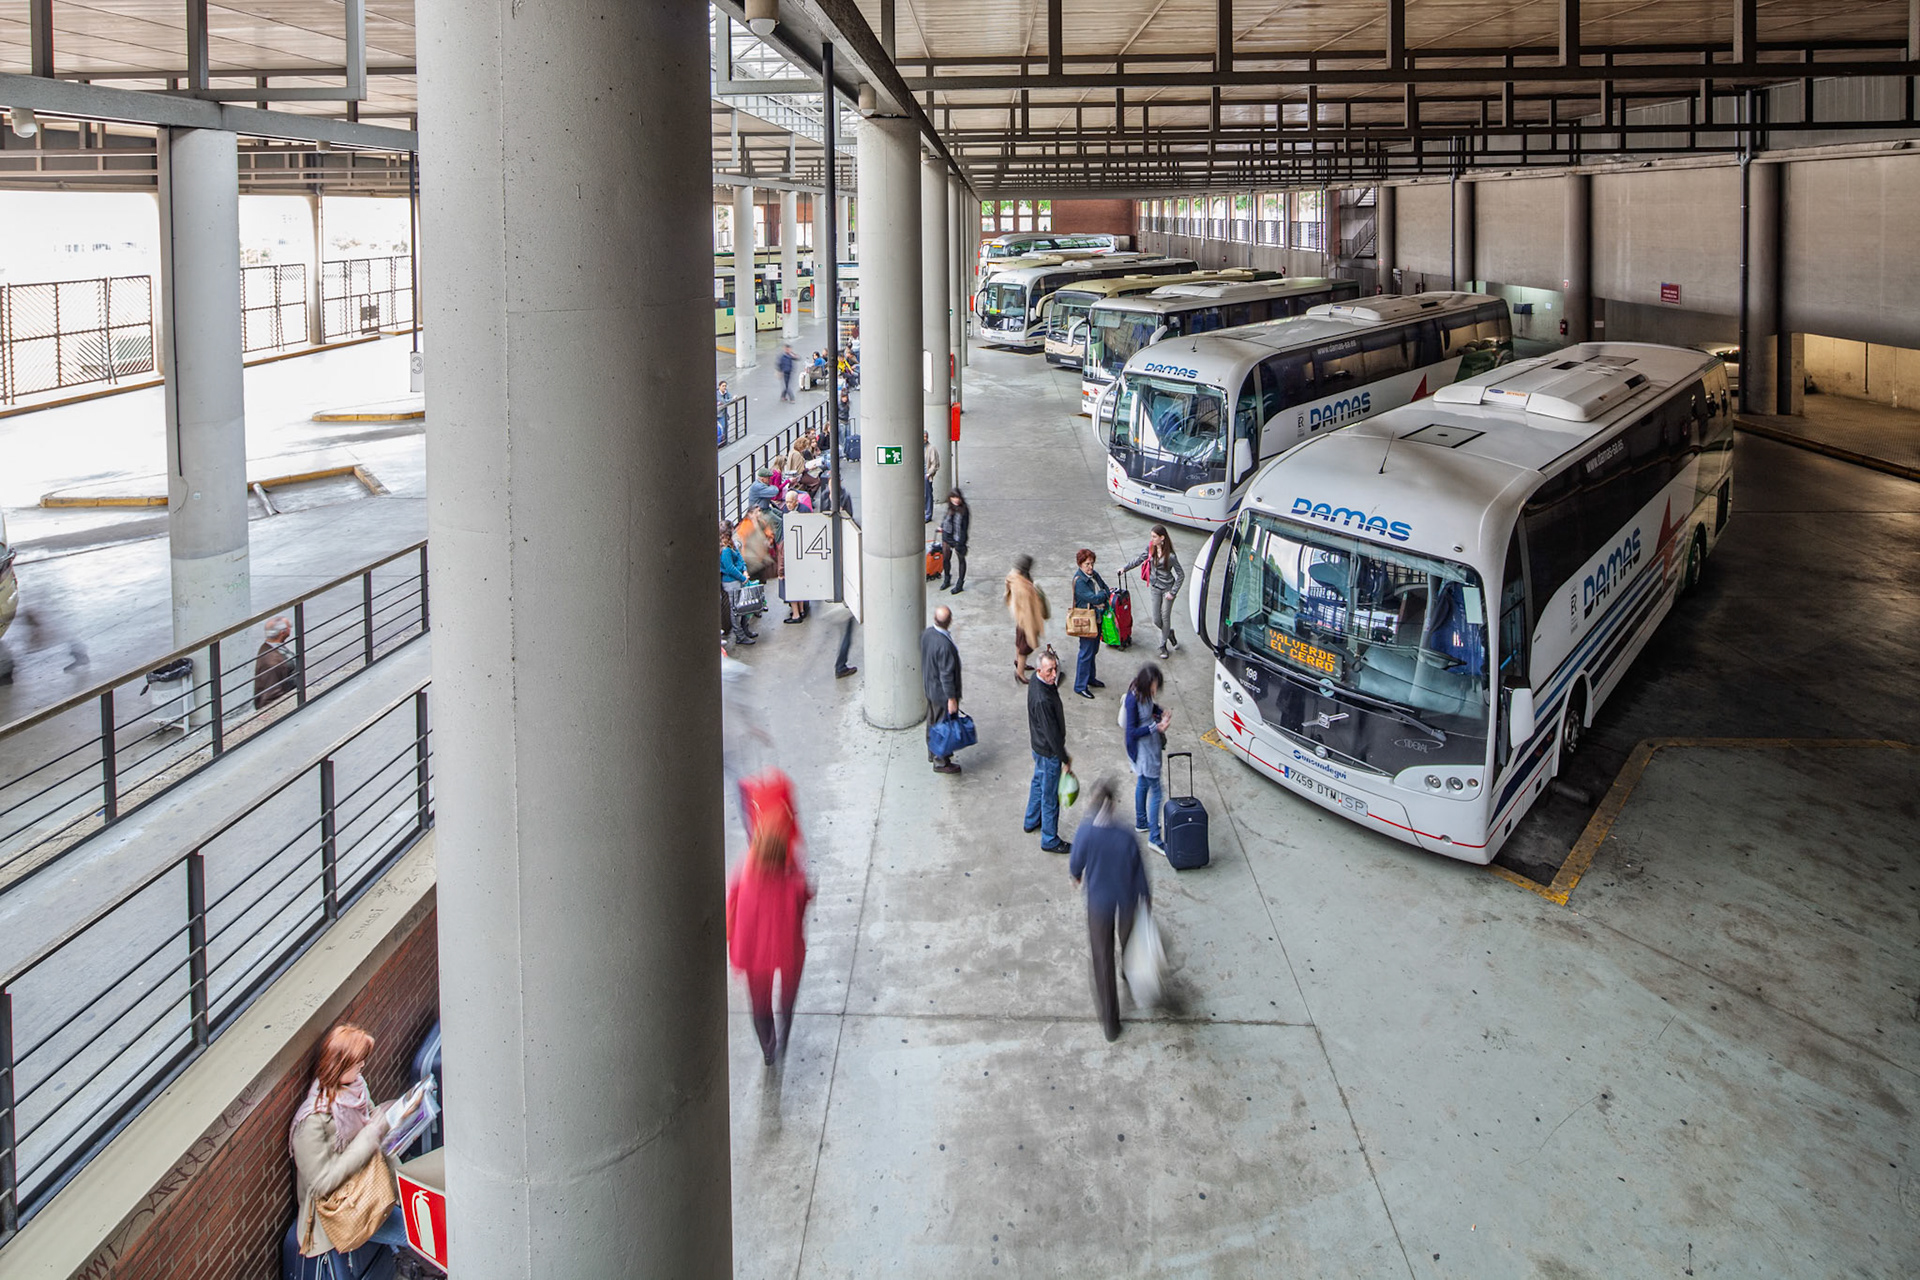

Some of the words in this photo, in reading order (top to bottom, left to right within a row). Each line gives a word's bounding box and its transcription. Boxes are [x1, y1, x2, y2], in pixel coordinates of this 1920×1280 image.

[1144, 362, 1199, 379] DAMAS
[1310, 391, 1371, 432] DAMAS
[1290, 497, 1413, 542] DAMAS
[790, 524, 832, 560] 14
[1583, 526, 1641, 621] DAMAS
[1269, 629, 1336, 664] VALVERDE
[1270, 638, 1286, 654] EL
[1289, 647, 1335, 673] CERRO
[1245, 666, 1259, 681] 198
[1290, 770, 1313, 789] 7459
[1317, 783, 1338, 801] DTM
[1344, 796, 1364, 812] SP
